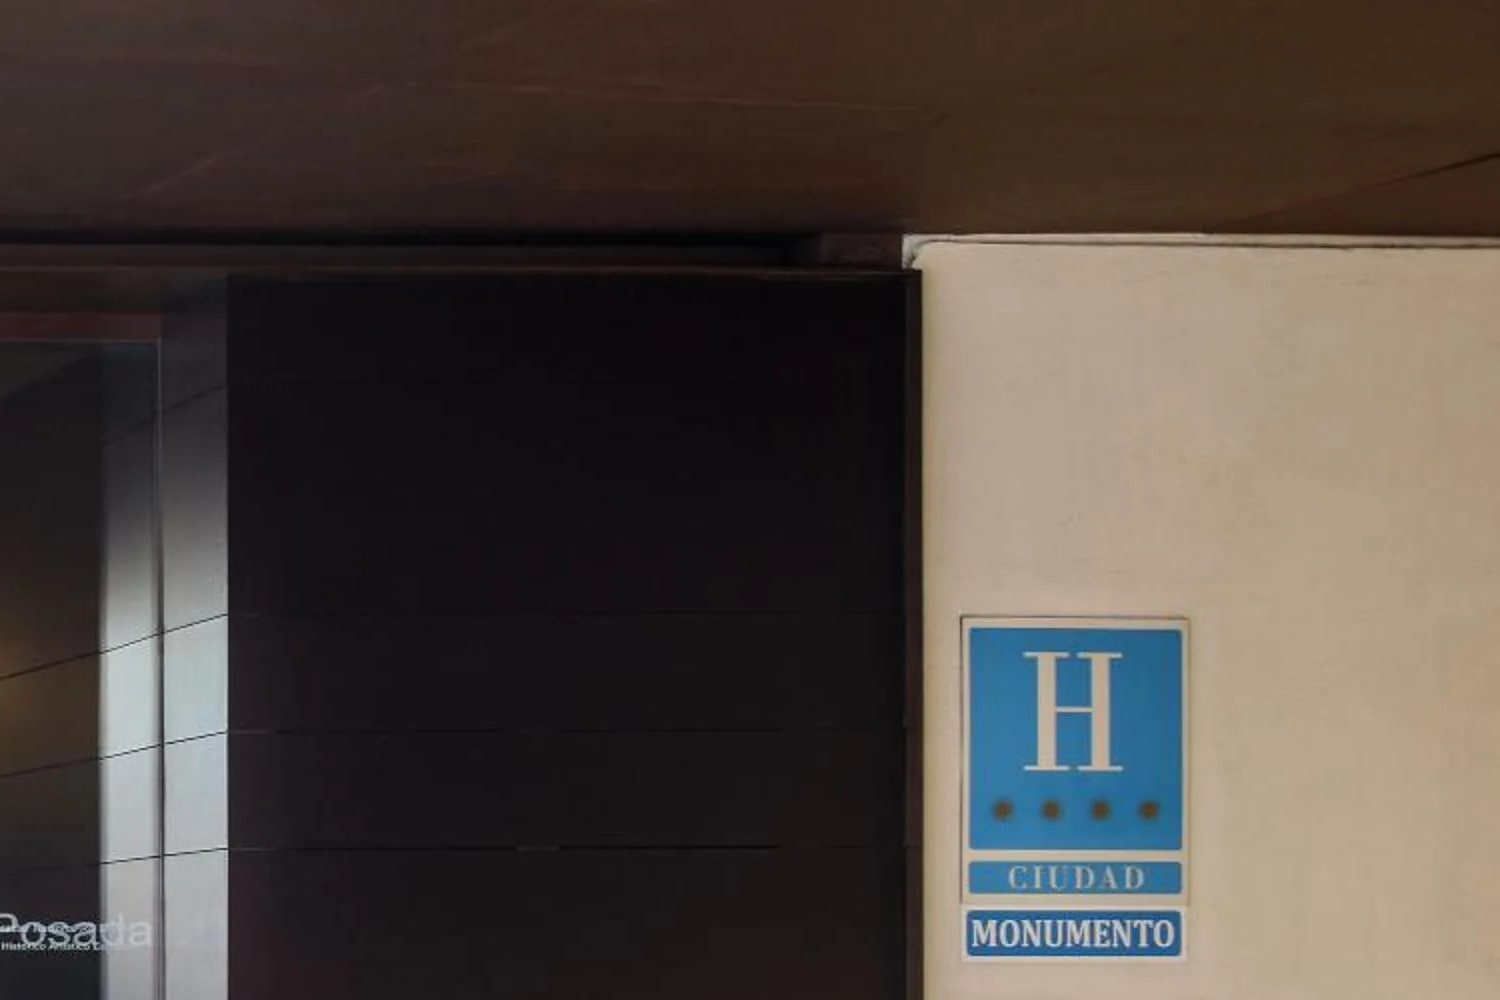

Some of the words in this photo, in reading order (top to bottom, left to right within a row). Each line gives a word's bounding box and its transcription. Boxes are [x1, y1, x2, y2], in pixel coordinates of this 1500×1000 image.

[1023, 651, 1124, 772] H
[1008, 865, 1145, 890] CIUDAD
[971, 918, 1175, 949] MONUMENTO
